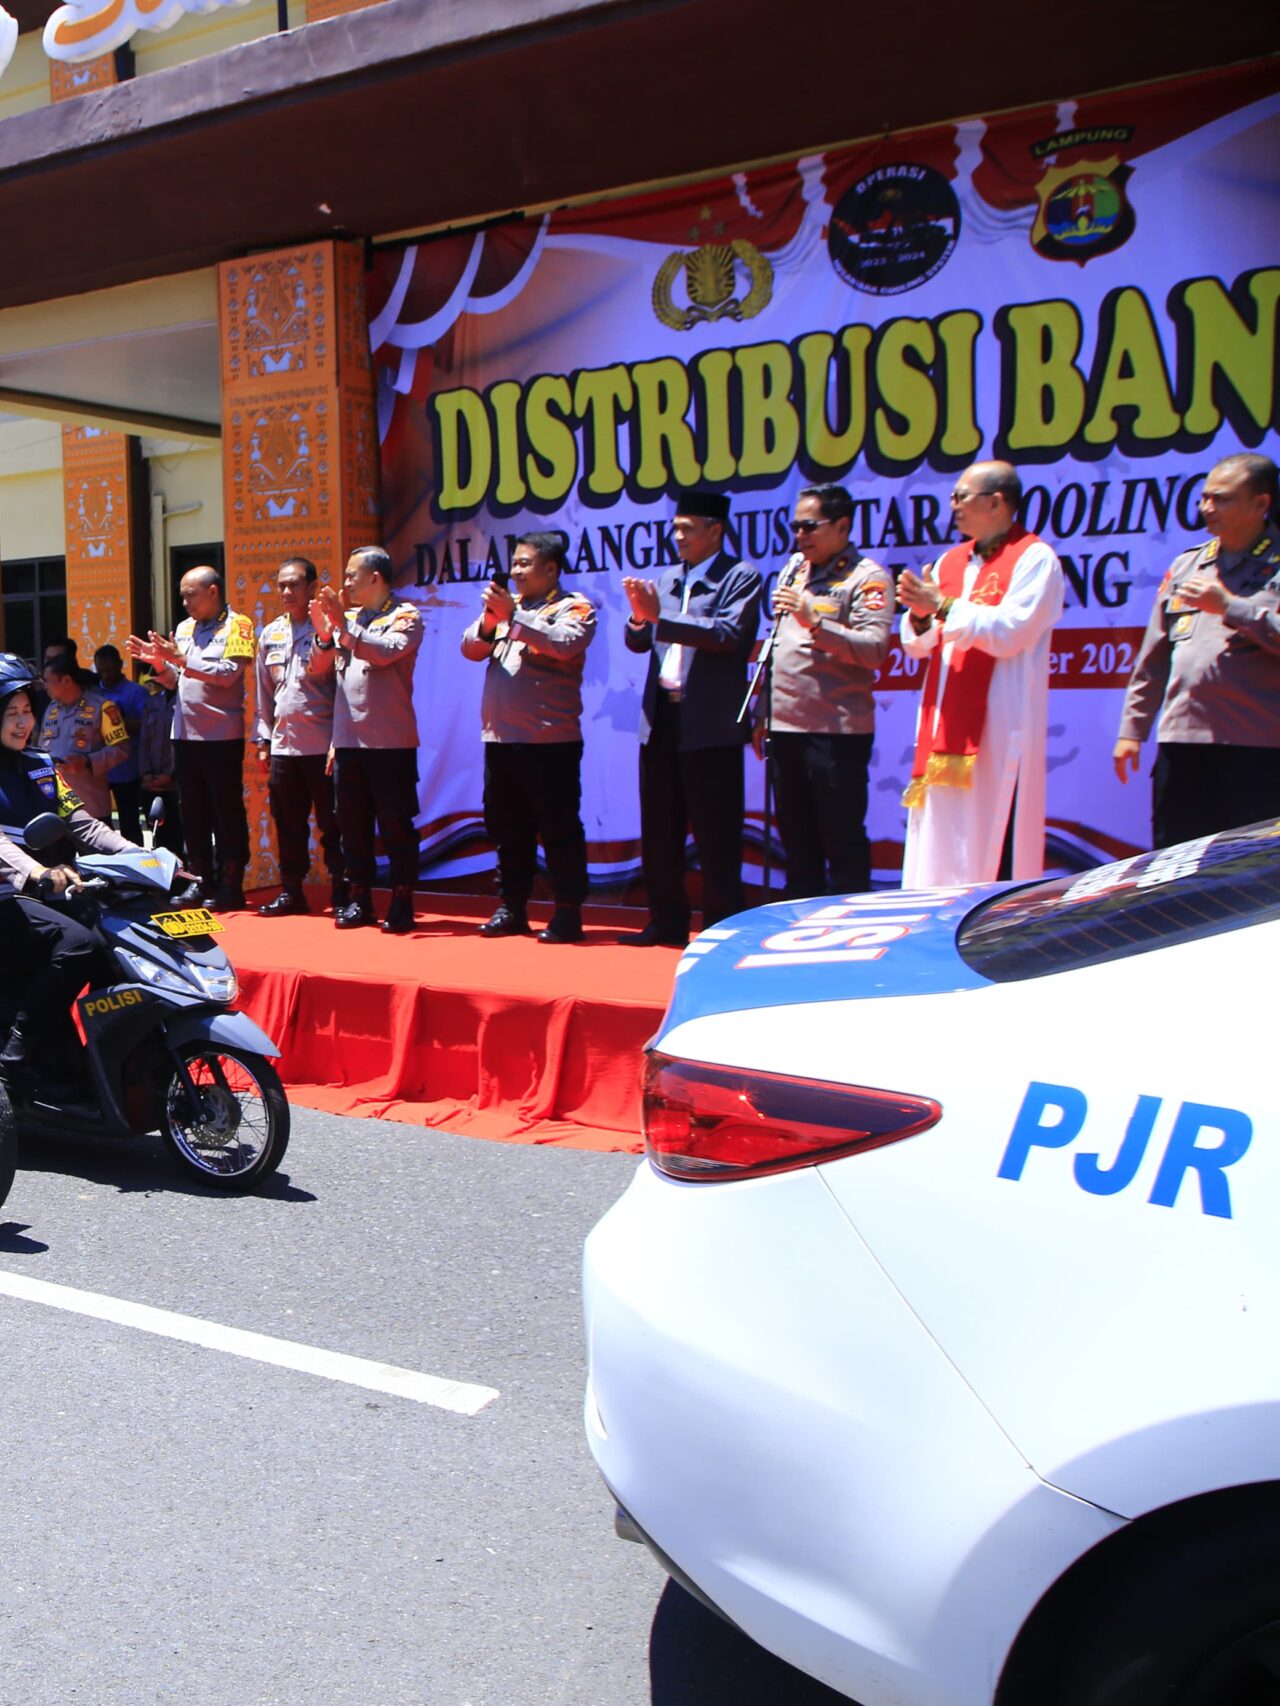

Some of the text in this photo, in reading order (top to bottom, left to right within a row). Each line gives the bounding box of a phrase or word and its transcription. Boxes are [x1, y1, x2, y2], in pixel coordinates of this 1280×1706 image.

[1035, 129, 1128, 155] LAMPUNG
[855, 166, 927, 194] OPERASI
[431, 309, 982, 520] DISTRIBUSI
[548, 518, 682, 574] RANGK
[1081, 642, 1137, 674] 202
[733, 888, 974, 969] OLISI
[84, 990, 143, 1017] POLISI
[997, 1081, 1253, 1219] PJR
